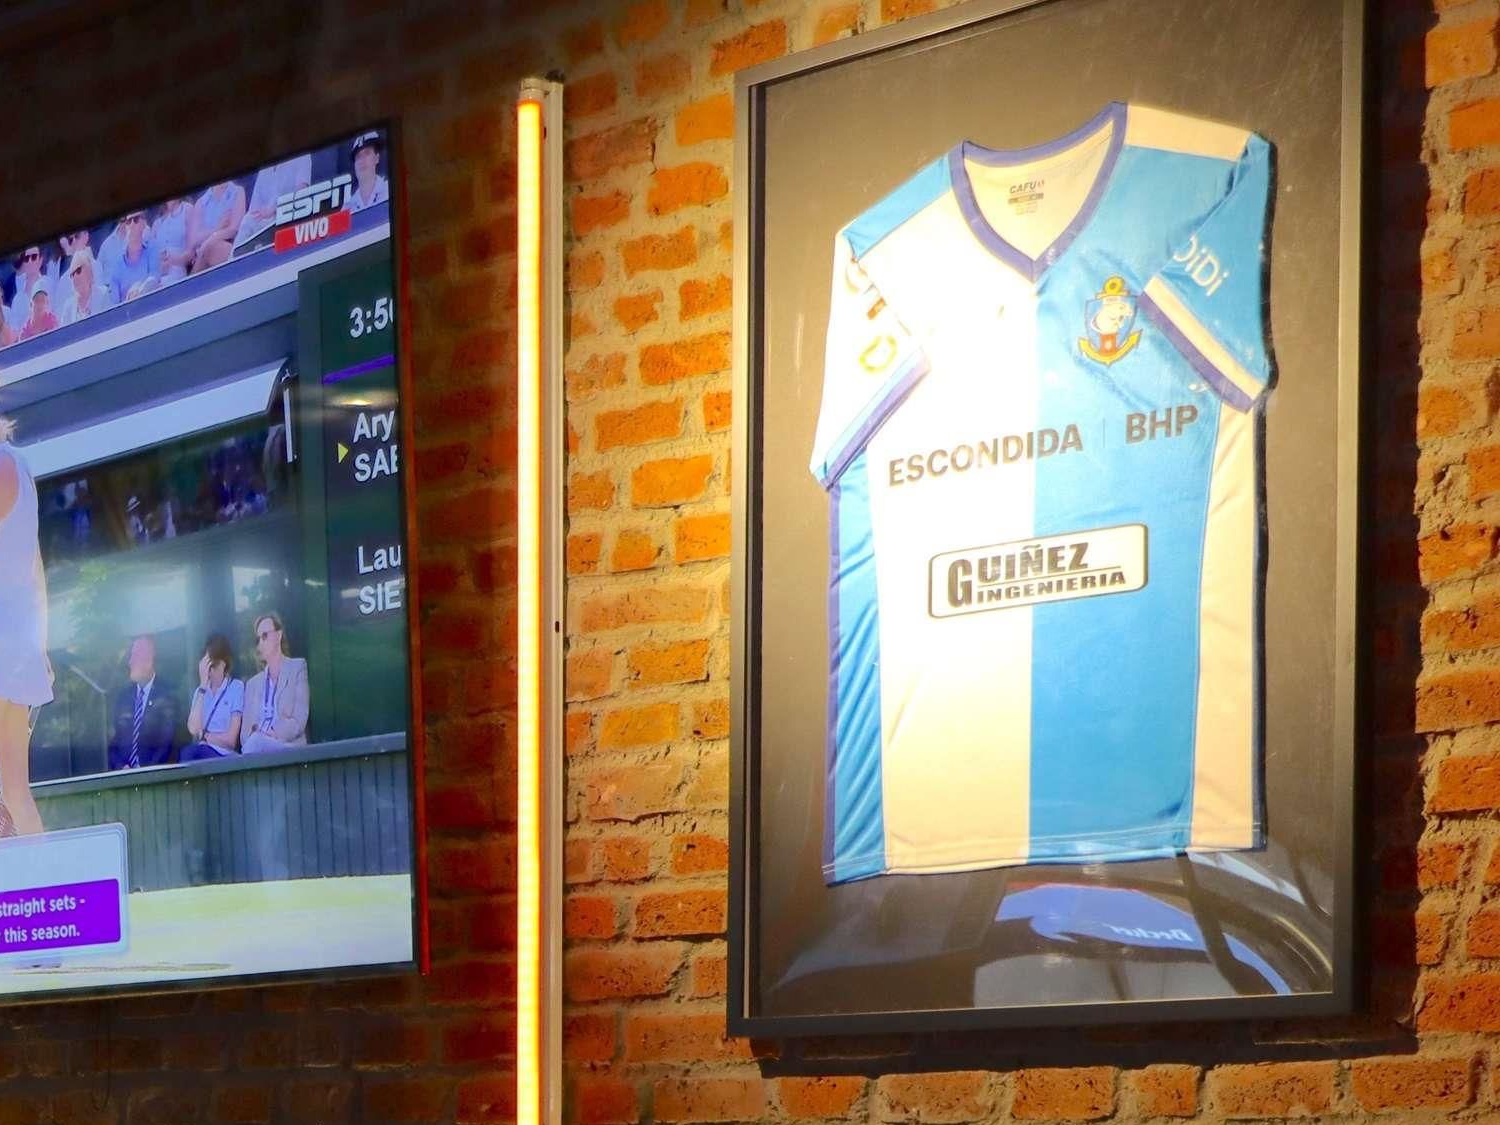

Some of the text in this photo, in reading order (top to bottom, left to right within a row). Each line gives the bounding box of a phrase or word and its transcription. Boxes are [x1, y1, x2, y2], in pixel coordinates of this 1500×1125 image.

[276, 173, 352, 226] ESPN
[294, 217, 329, 245] VIVO
[349, 297, 394, 338] 3:5
[888, 404, 1198, 487] ESCONDIDA BHP
[947, 542, 1090, 608] GUIÑEZ
[977, 571, 1126, 604] INGENIERIA
[50, 894, 76, 912] sets
[4, 926, 28, 944] this
[31, 923, 81, 940] season.
